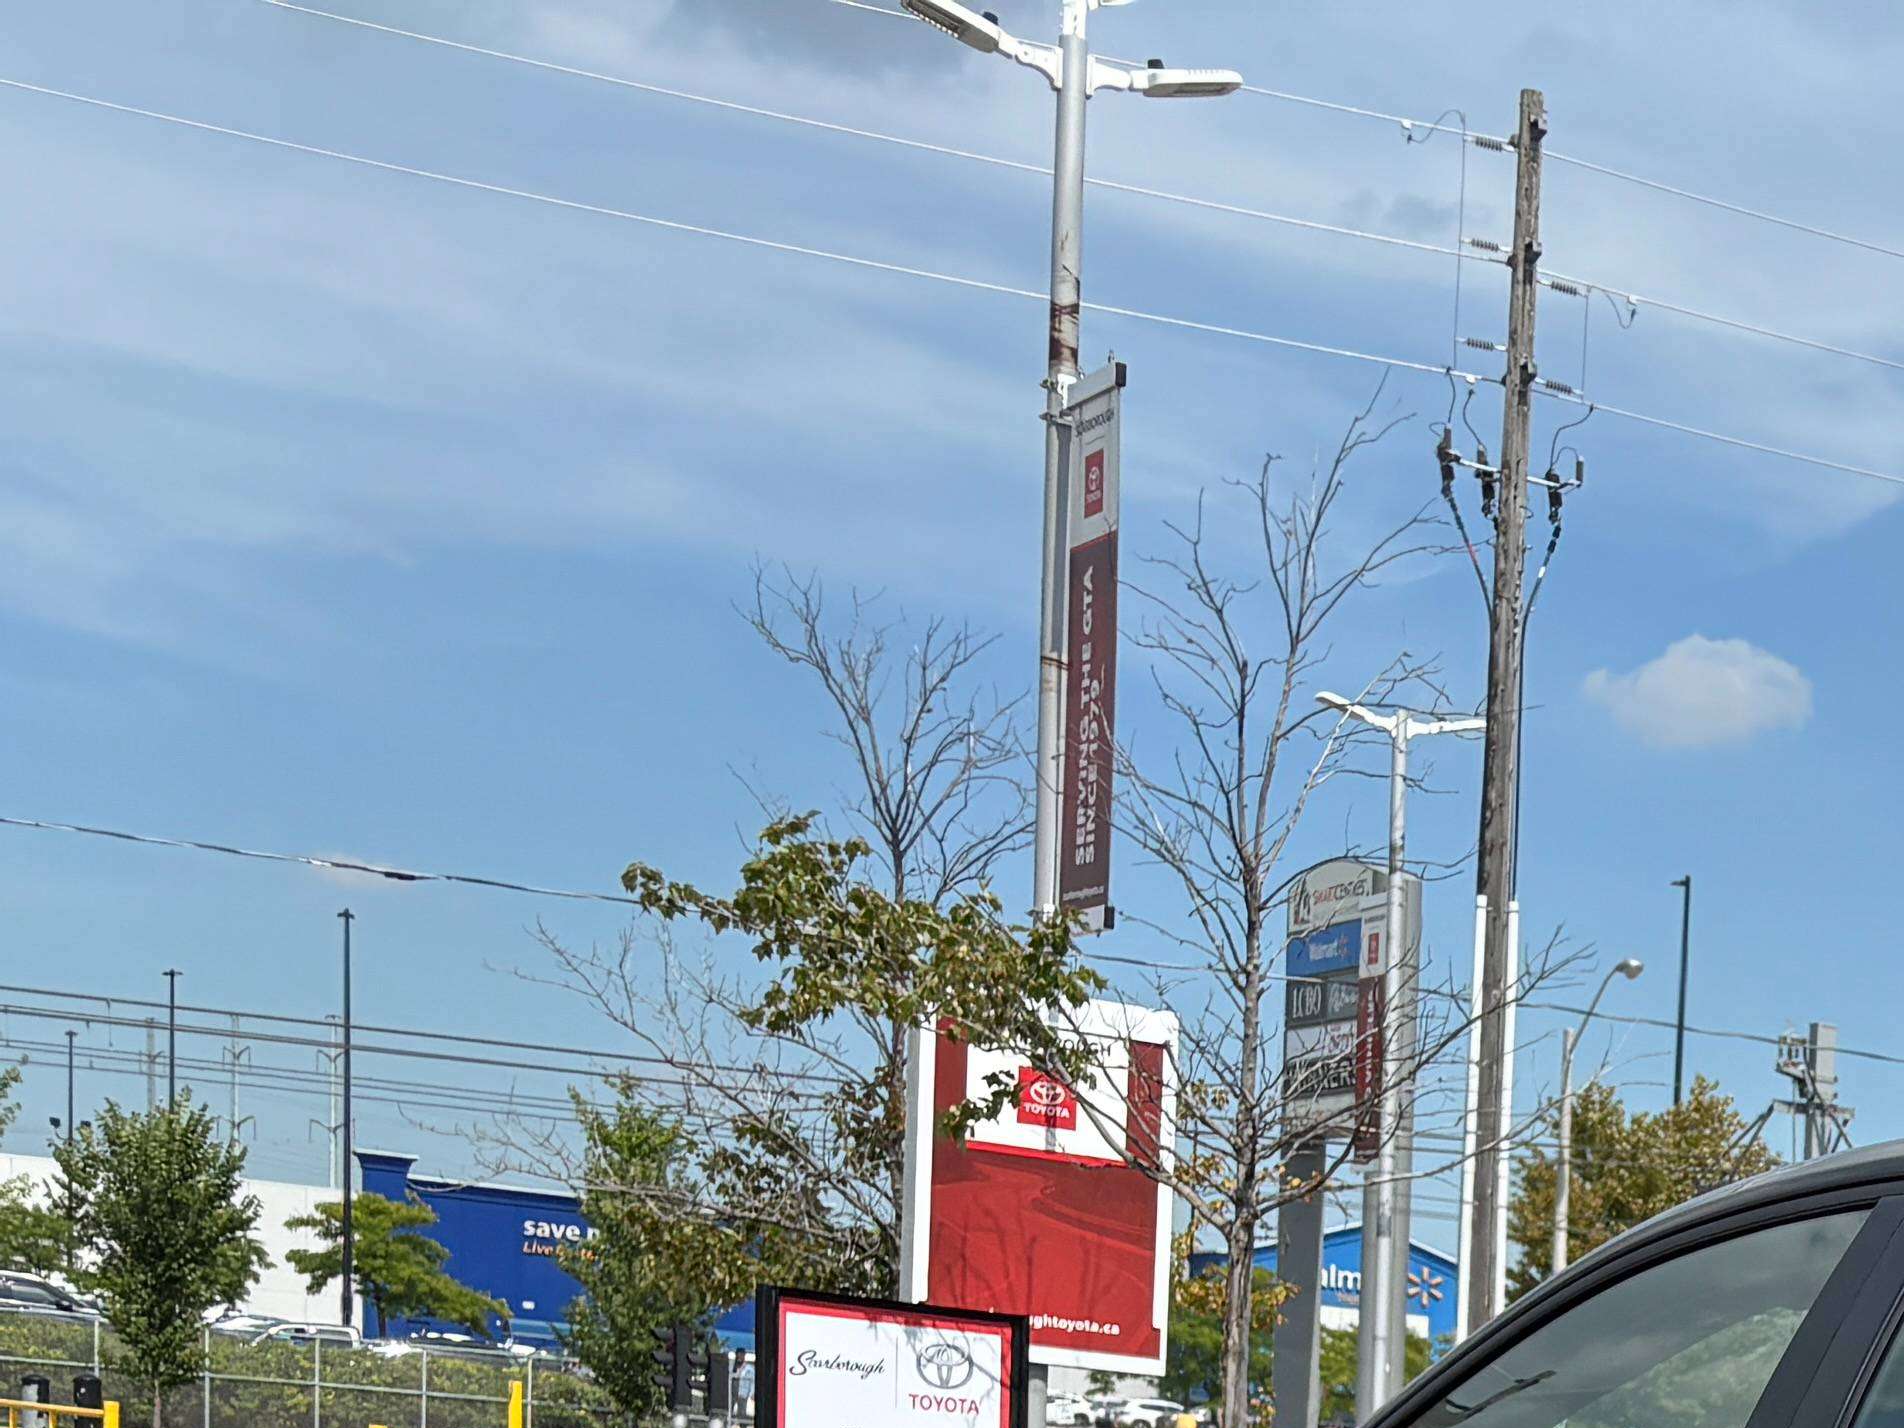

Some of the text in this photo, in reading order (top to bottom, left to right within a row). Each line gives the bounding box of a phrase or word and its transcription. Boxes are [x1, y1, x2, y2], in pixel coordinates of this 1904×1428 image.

[1076, 565, 1094, 866] SERVING THE GTA
[1085, 763, 1098, 864] SINCE
[1023, 1102, 1070, 1119] TOYOTA
[523, 1220, 581, 1241] save
[789, 1349, 887, 1380] Scarborough
[908, 1393, 979, 1415] TOYOTA
